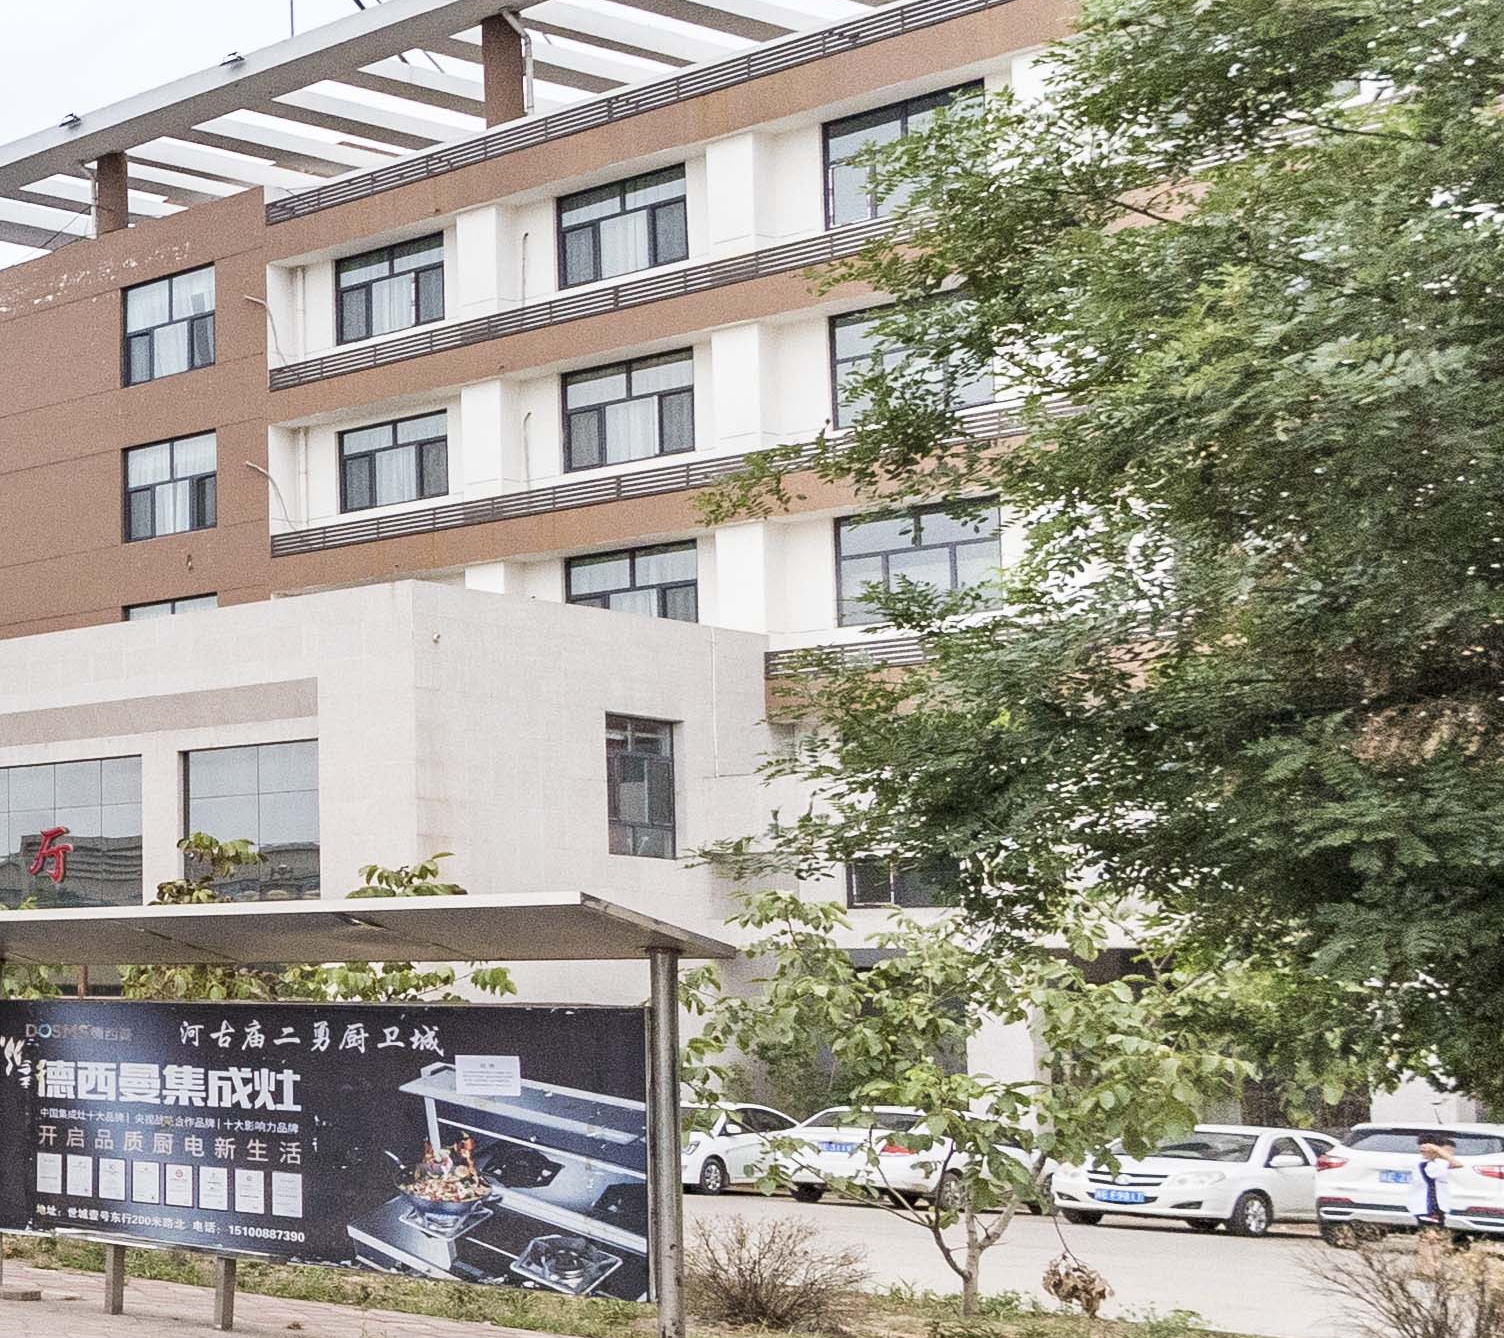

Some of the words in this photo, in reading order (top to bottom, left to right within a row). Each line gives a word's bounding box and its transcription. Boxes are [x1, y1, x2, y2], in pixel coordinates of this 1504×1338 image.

[179, 1021, 445, 1057] 河古庙二勇厨卫城
[36, 1059, 302, 1112] 德西曼集成灶
[38, 1124, 303, 1165] 开启品质厨电新生活
